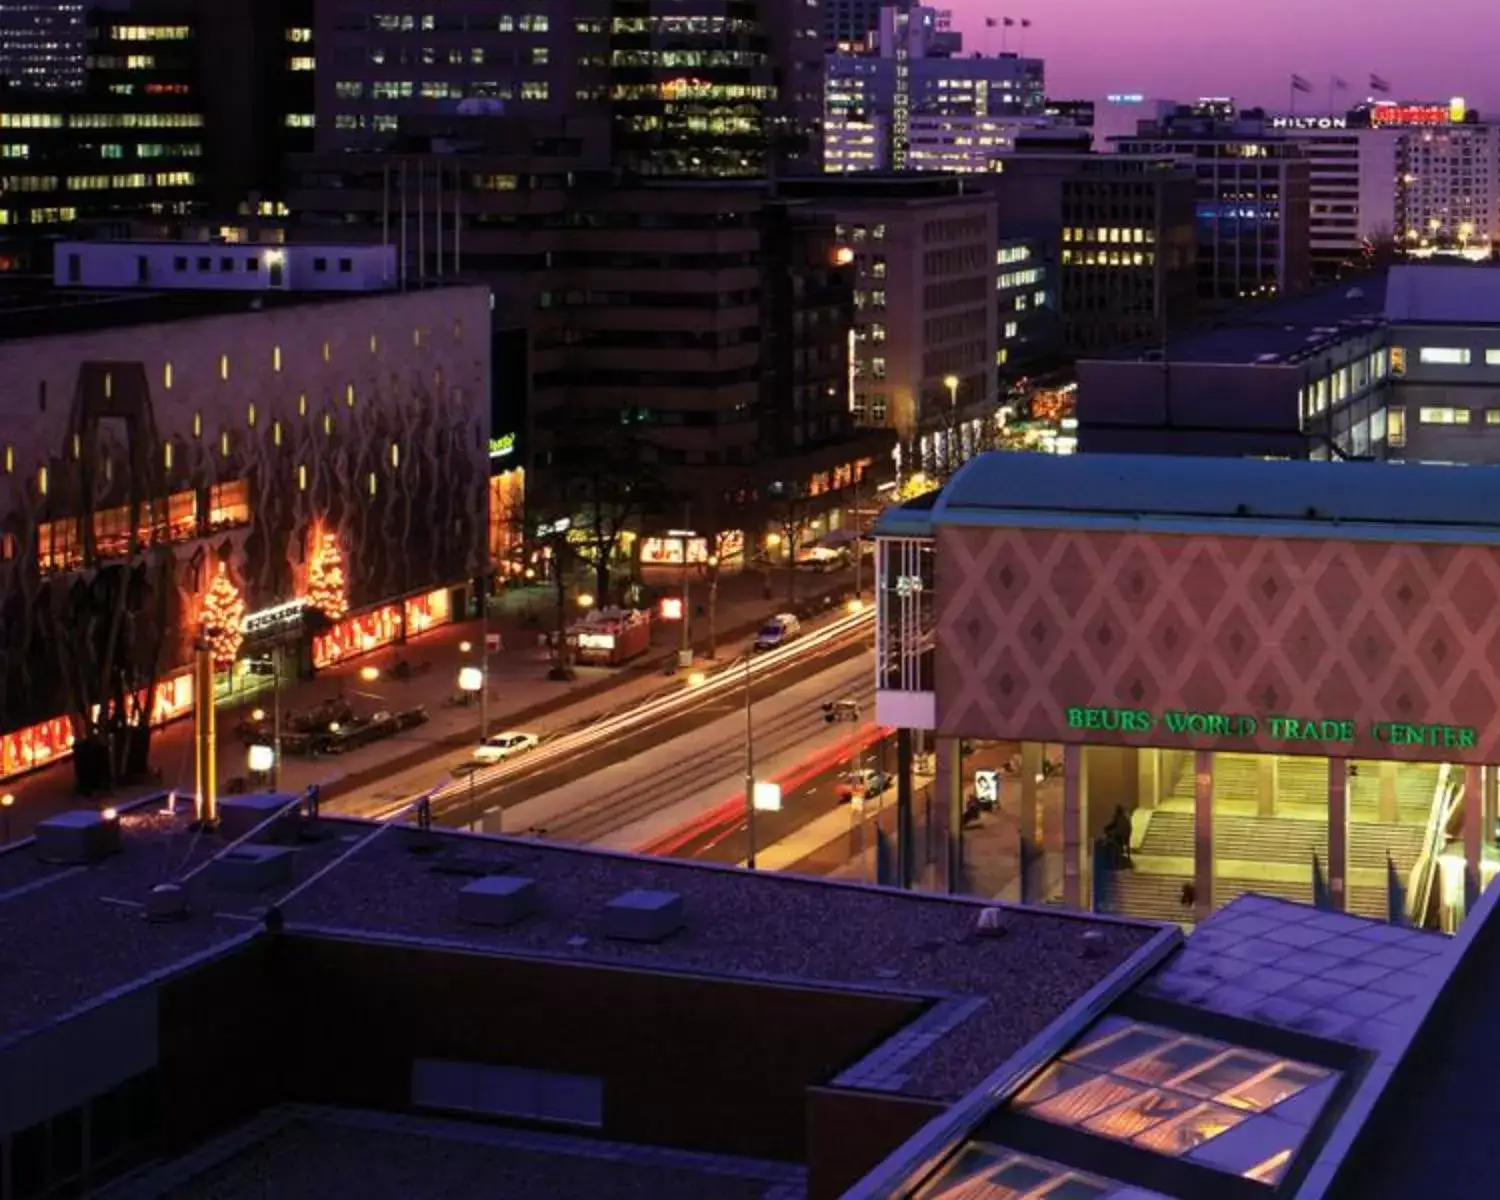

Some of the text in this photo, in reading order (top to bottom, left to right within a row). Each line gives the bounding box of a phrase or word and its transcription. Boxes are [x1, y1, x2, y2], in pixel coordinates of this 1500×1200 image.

[1273, 117, 1346, 129] HILTON
[1068, 707, 1476, 747] BEURS WORLD TRADE CENTER
